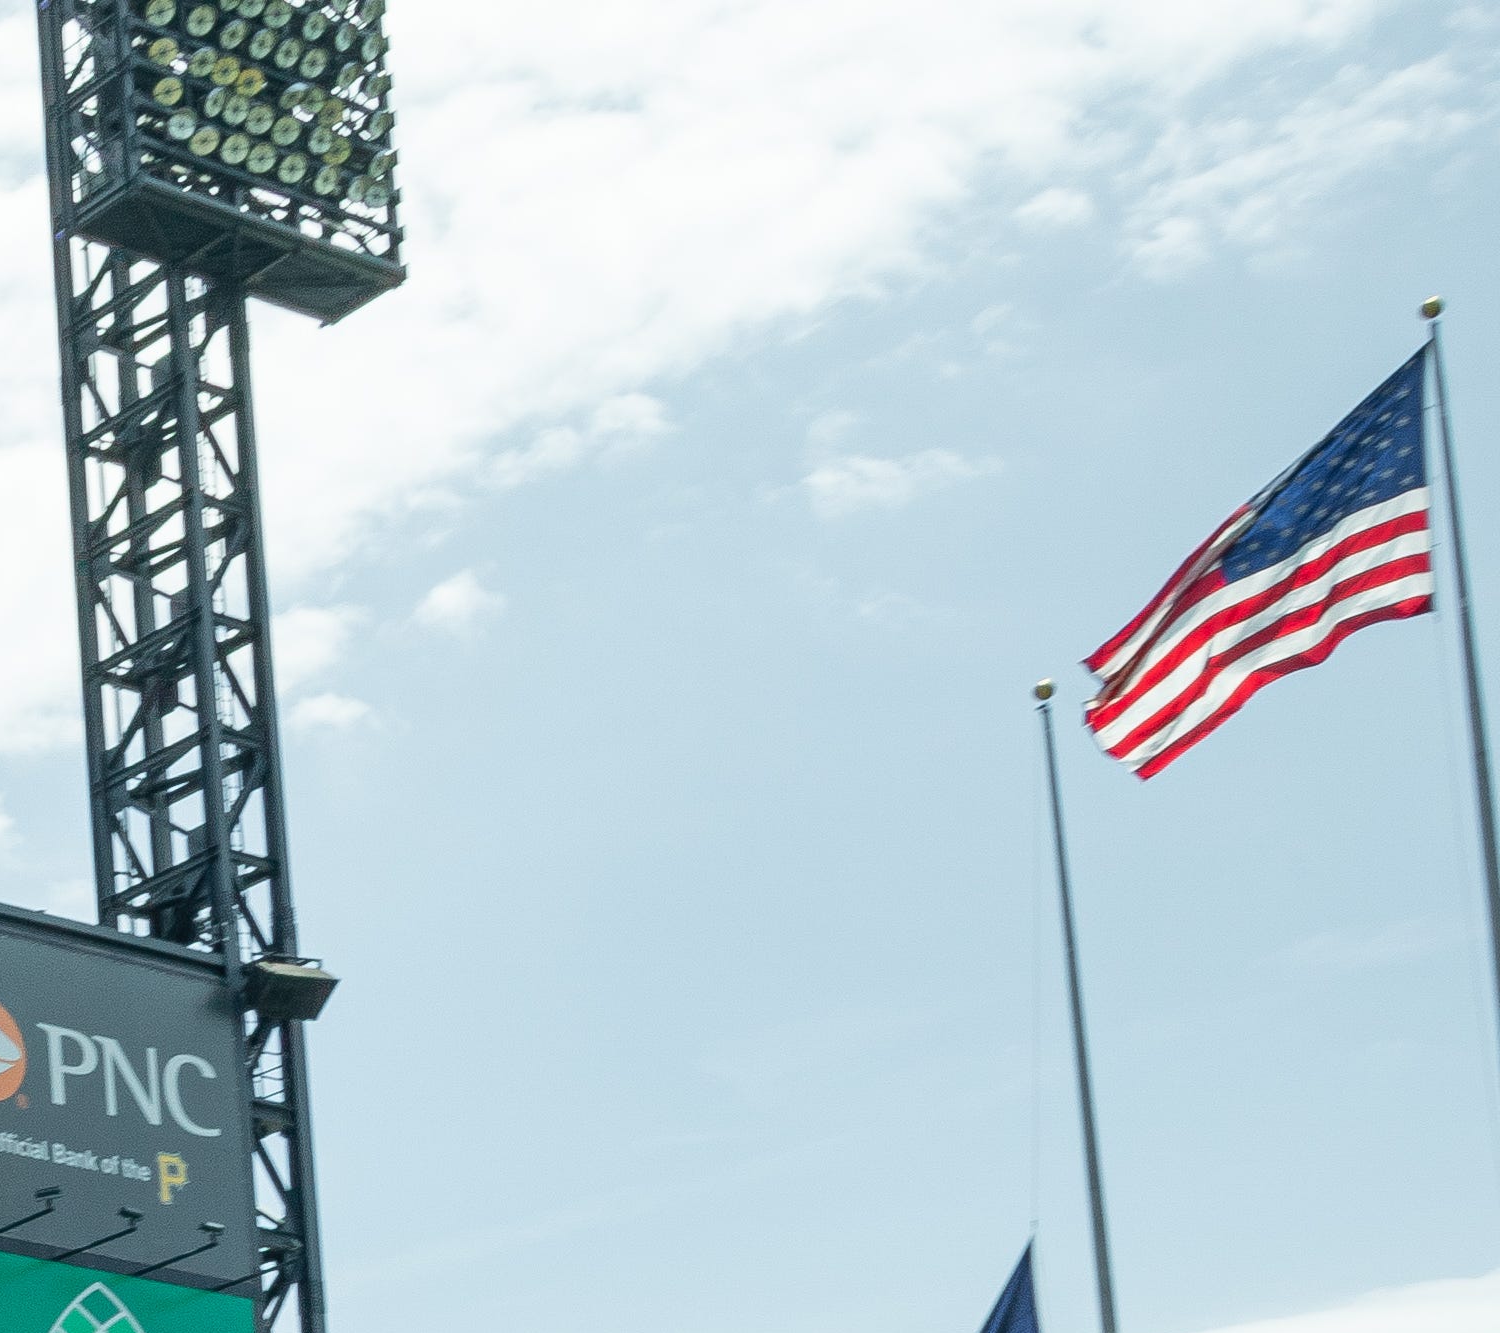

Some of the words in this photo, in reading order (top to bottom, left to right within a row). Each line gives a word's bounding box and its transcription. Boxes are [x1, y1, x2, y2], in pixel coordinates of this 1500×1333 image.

[35, 1022, 222, 1137] PNC
[52, 1143, 99, 1171] Bank
[101, 1155, 120, 1175] of
[121, 1158, 152, 1181] the
[156, 1152, 190, 1206] P
